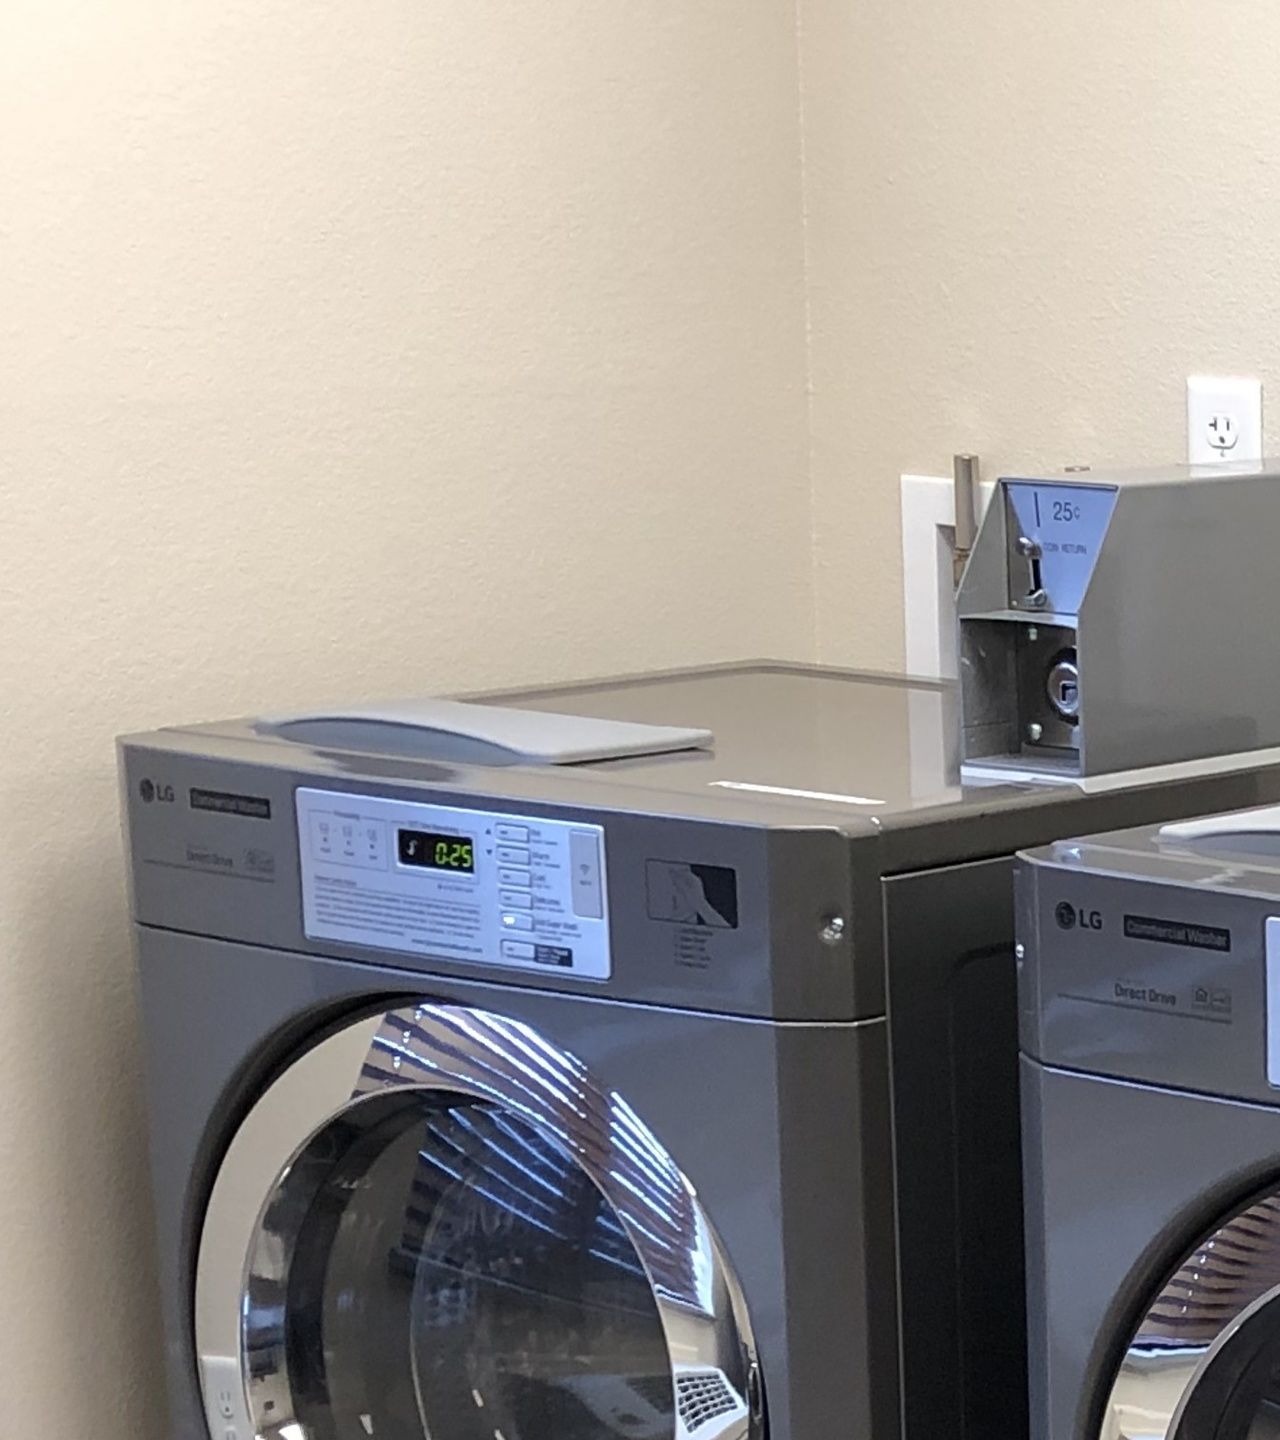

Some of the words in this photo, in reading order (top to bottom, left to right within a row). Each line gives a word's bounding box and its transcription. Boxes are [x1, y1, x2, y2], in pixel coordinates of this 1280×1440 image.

[156, 784, 175, 802] LG
[1079, 908, 1103, 930] LG
[1114, 982, 1146, 1001] Direct
